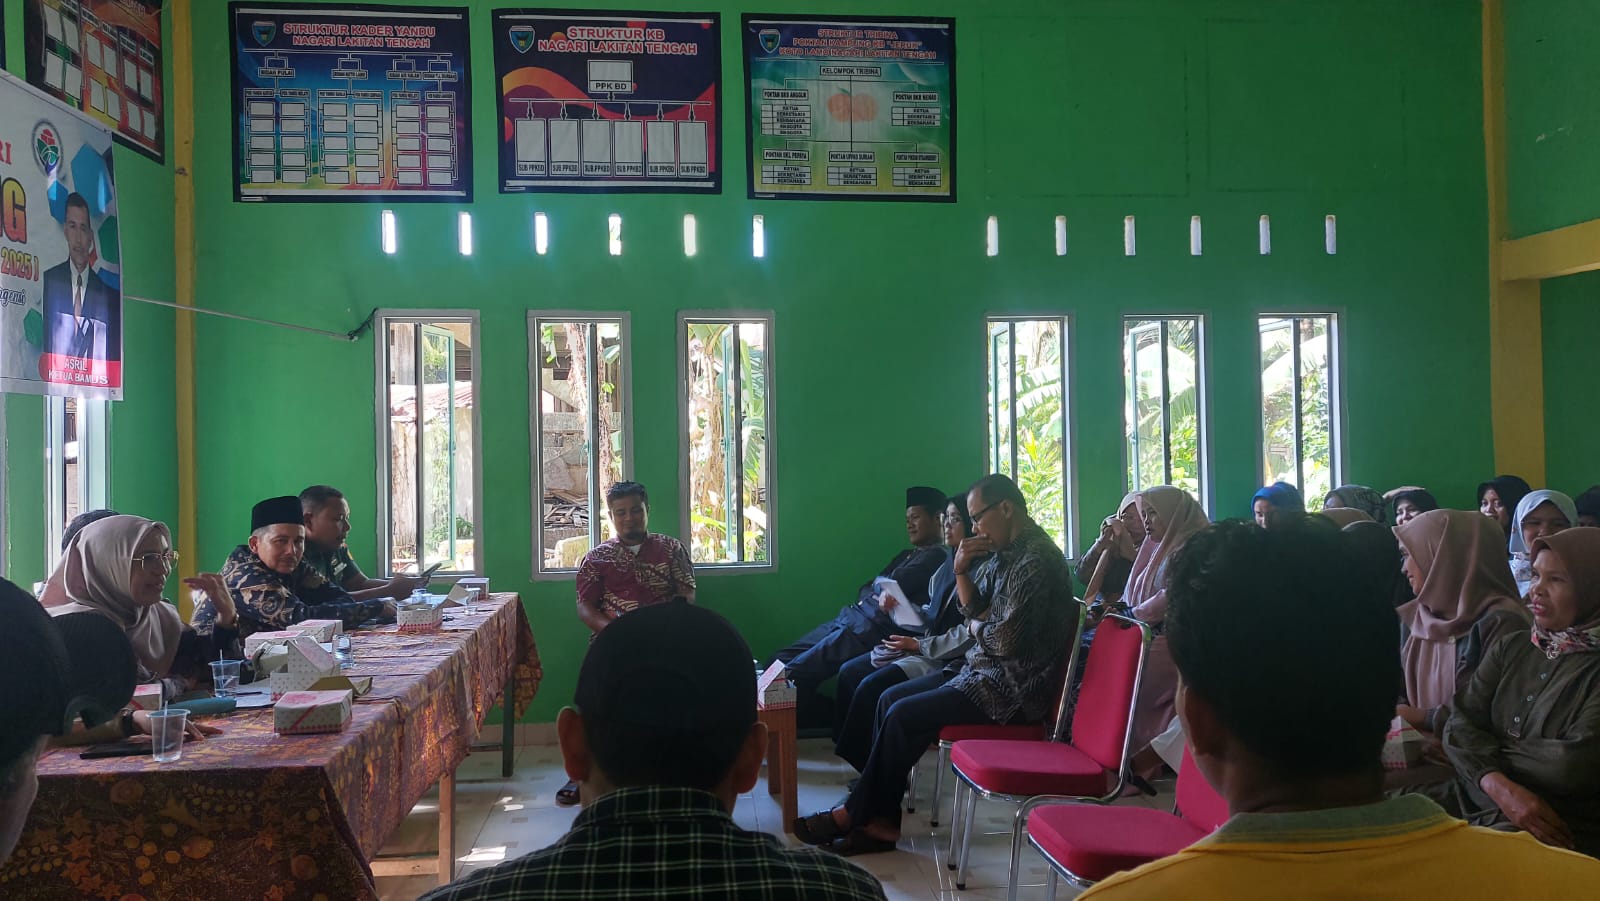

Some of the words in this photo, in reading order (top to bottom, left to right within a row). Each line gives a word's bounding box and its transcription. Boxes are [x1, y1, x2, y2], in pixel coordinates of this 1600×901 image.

[283, 23, 349, 36] STRUKTUR
[351, 24, 394, 36] KADER
[395, 25, 436, 37] YANDU
[567, 26, 644, 40] STRUKTUR
[645, 28, 665, 41] KB
[818, 29, 863, 38] STRUKTUR
[865, 29, 898, 40] TRIBINA
[293, 35, 337, 46] NAGARI
[338, 36, 383, 47] LAKITAN
[385, 37, 431, 48] TENGAH
[538, 40, 588, 53] NAGARI
[590, 41, 643, 54] LAKITAN
[645, 42, 698, 55] TENGAH
[831, 48, 864, 57] NAGARI
[865, 49, 901, 58] LAKITAN
[902, 50, 937, 59] TENGAH
[822, 67, 855, 75] KELOMPOK
[595, 82, 614, 90] PPK
[0, 176, 27, 244] G
[64, 359, 88, 371] ASRIL
[48, 369, 73, 381] KETUA
[75, 371, 108, 384] BAMUS
